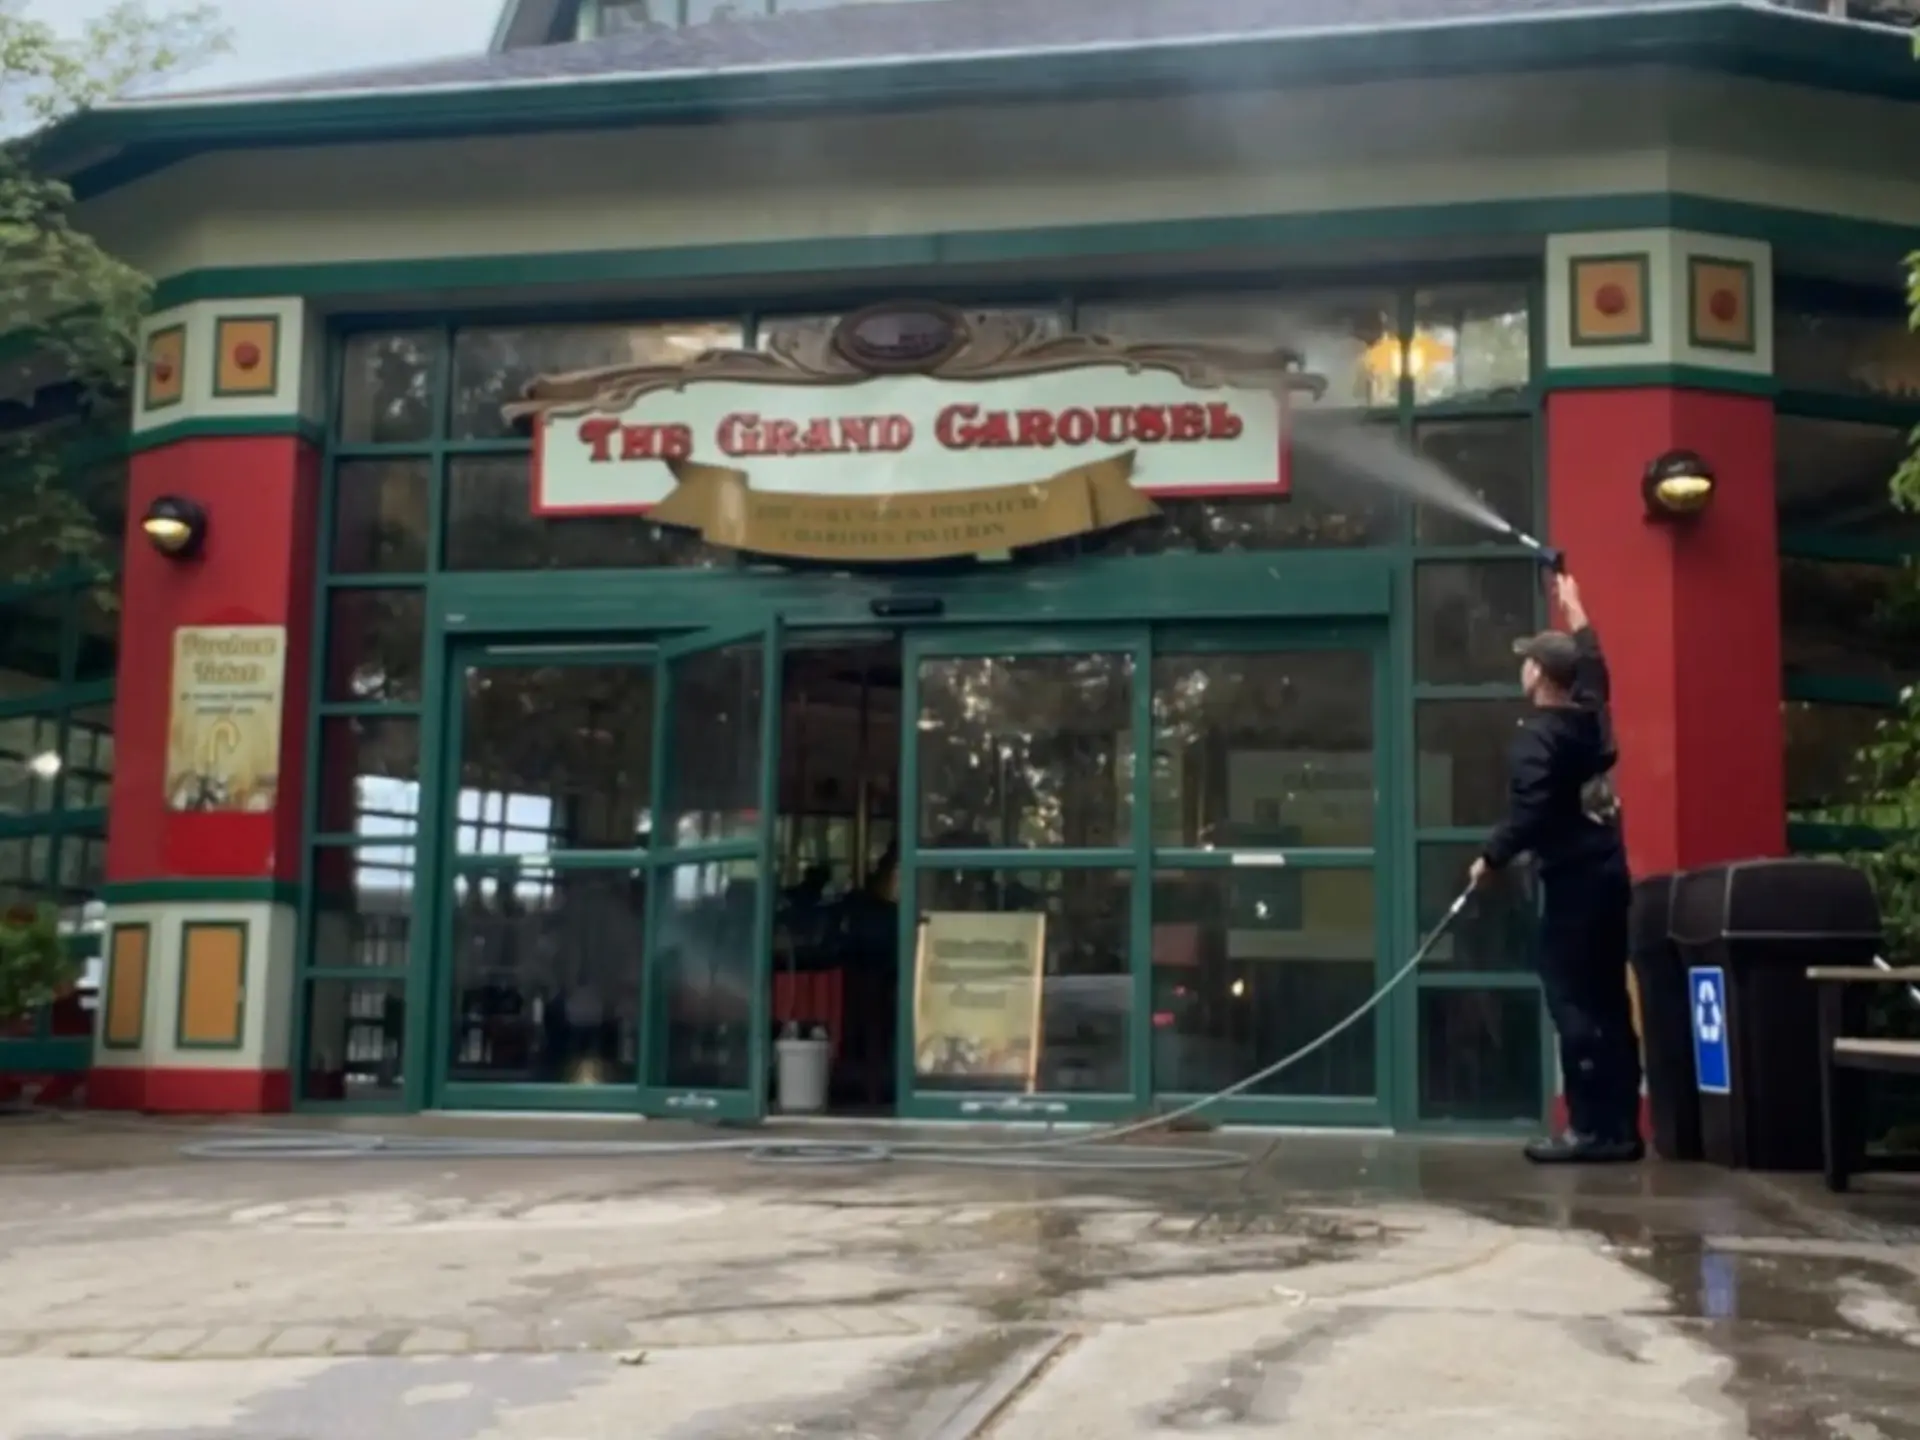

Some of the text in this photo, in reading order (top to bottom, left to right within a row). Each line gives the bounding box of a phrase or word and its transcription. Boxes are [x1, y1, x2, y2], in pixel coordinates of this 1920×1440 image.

[578, 402, 1243, 463] THE GRAND CAROUSEL
